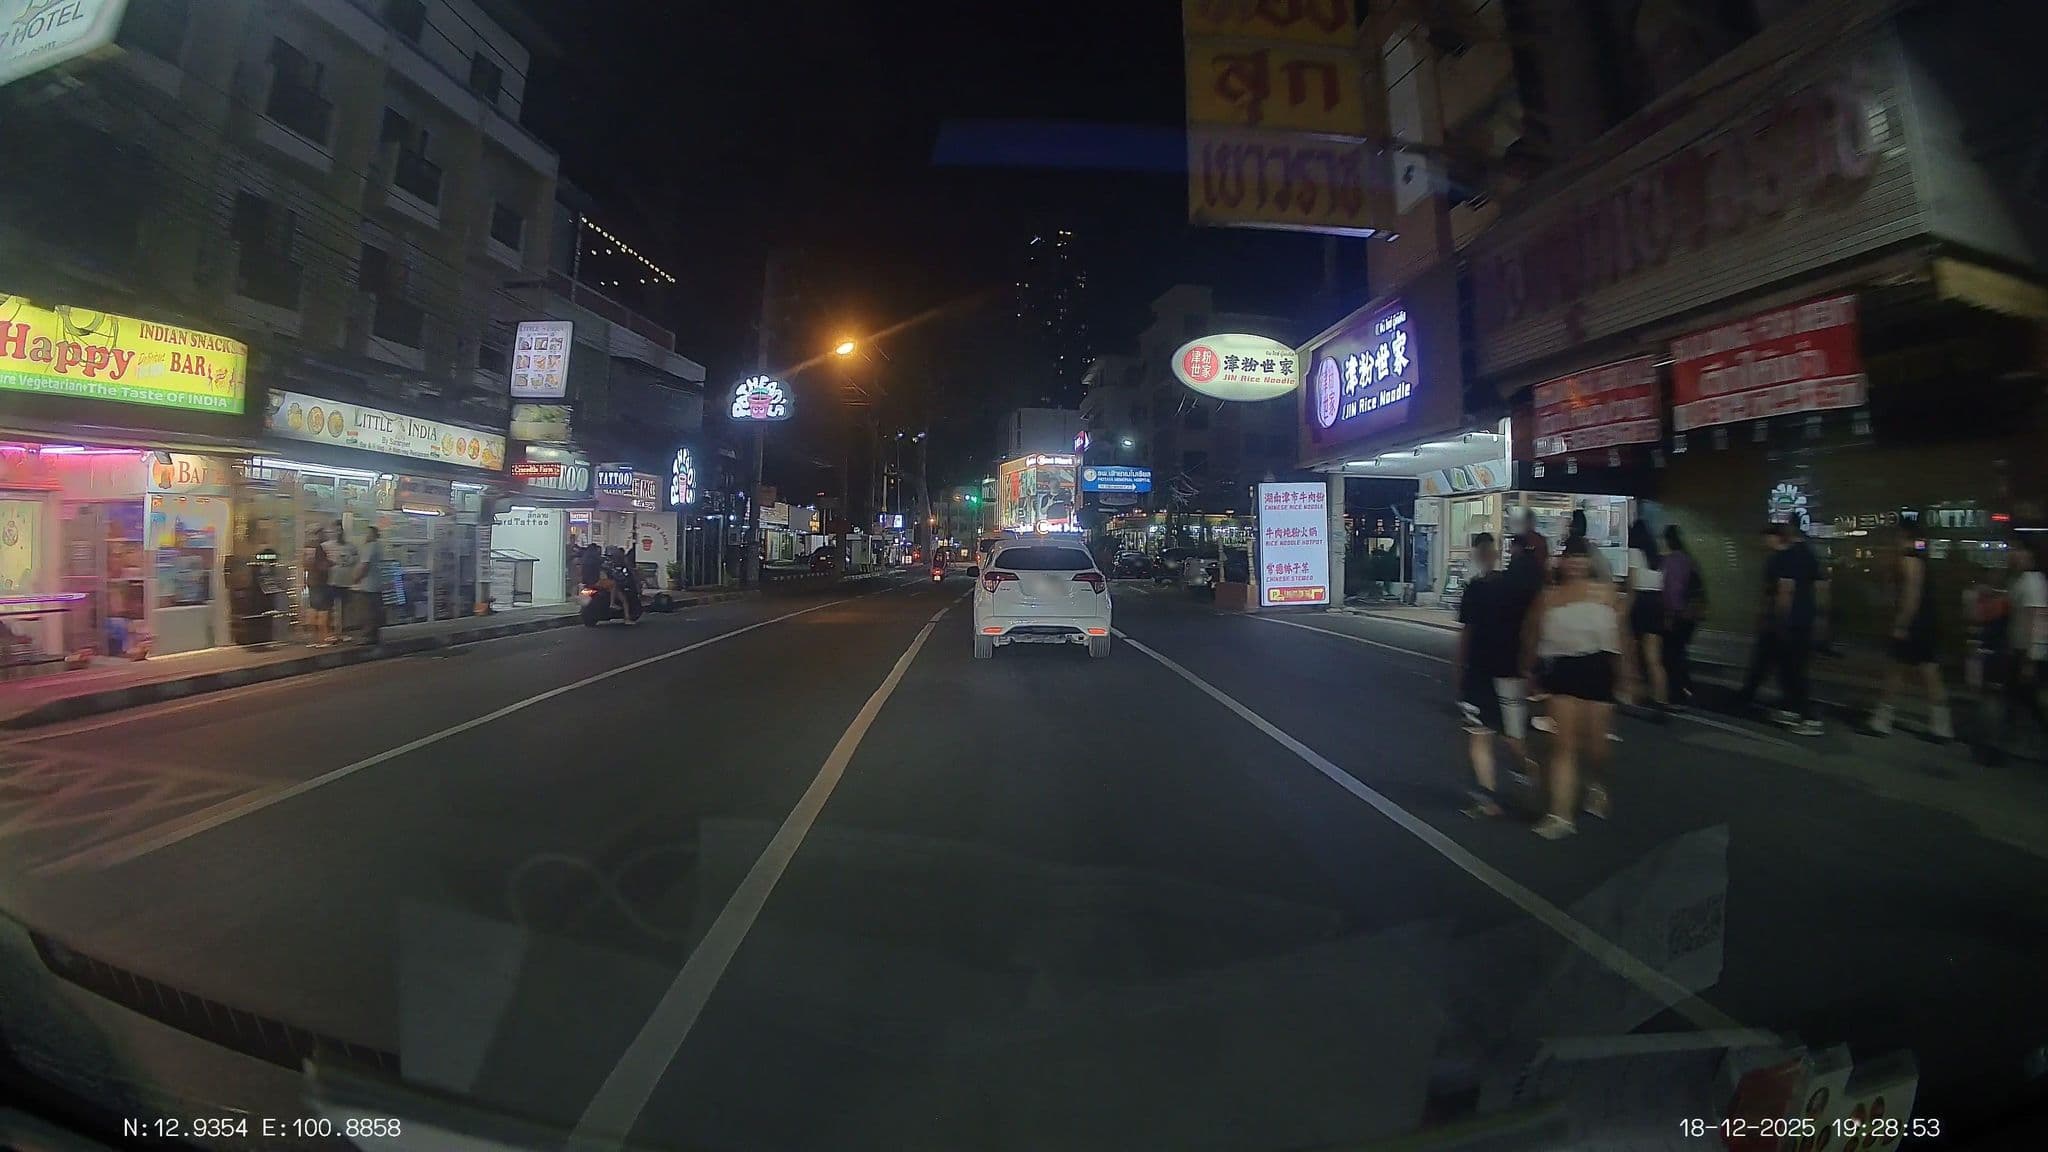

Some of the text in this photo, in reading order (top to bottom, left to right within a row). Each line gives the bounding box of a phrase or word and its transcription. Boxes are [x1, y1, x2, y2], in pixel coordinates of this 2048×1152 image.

[12, 1, 84, 46] HOTEL
[0, 320, 135, 380] Happy
[140, 323, 187, 345] INDIAN
[170, 351, 206, 377] BAR
[1223, 354, 1295, 376] 津粉世家
[1223, 374, 1296, 385] JIN Rice Noodle
[1344, 330, 1410, 396] 津粉世家
[19, 374, 83, 393] Vegetarian
[87, 382, 117, 396] The
[121, 386, 163, 401] Taste
[188, 394, 228, 407] INDIA
[1342, 381, 1411, 420] JIN Rice Noodle
[354, 407, 437, 441] LITTLE INDIA
[598, 472, 630, 485] TATTOO
